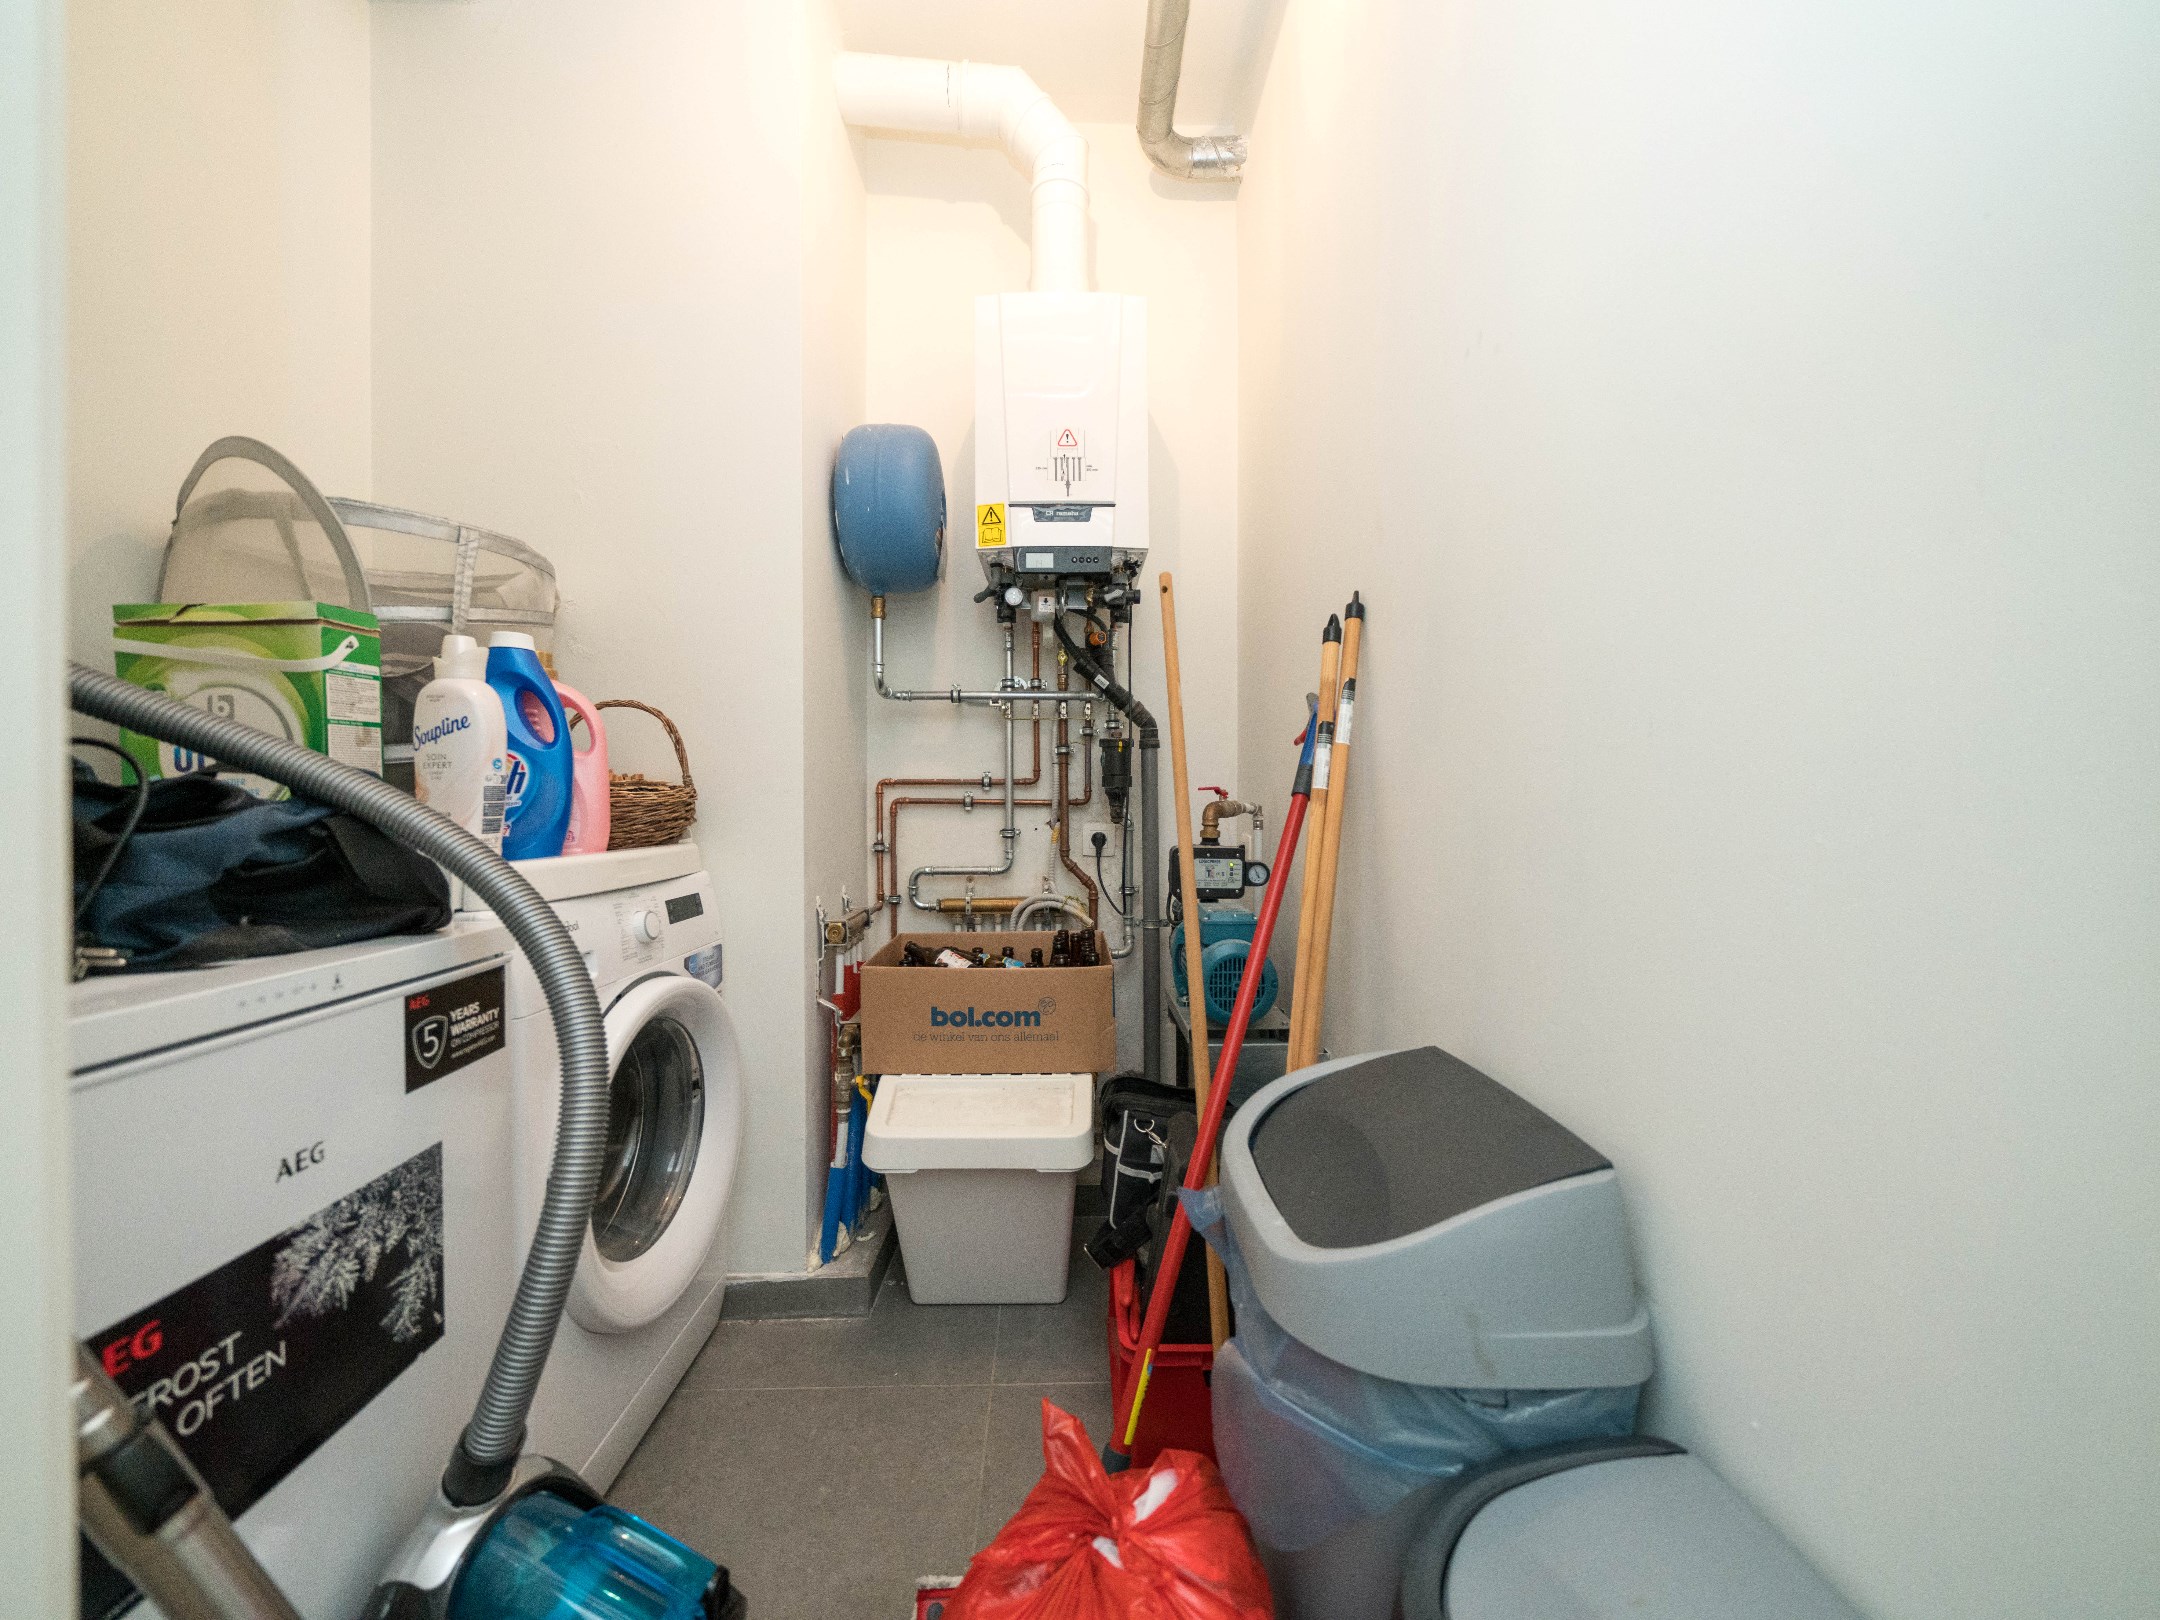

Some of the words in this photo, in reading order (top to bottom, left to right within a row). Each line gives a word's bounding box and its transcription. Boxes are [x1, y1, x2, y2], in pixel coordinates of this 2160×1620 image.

[414, 715, 471, 751] Soupline
[422, 760, 453, 770] EXPERT
[426, 752, 448, 761] SOIN
[408, 993, 430, 1011] AEG
[449, 1001, 480, 1022] YEARS
[449, 1007, 500, 1036] WARRANTY
[931, 1006, 1041, 1027] bol.com
[423, 1023, 440, 1058] 5
[913, 1031, 927, 1041] de
[930, 1031, 965, 1041] winkel
[1013, 1031, 1059, 1041] allemaal
[275, 1140, 325, 1184] AEG
[102, 1318, 164, 1378] EG
[176, 1340, 286, 1436] OFTEN
